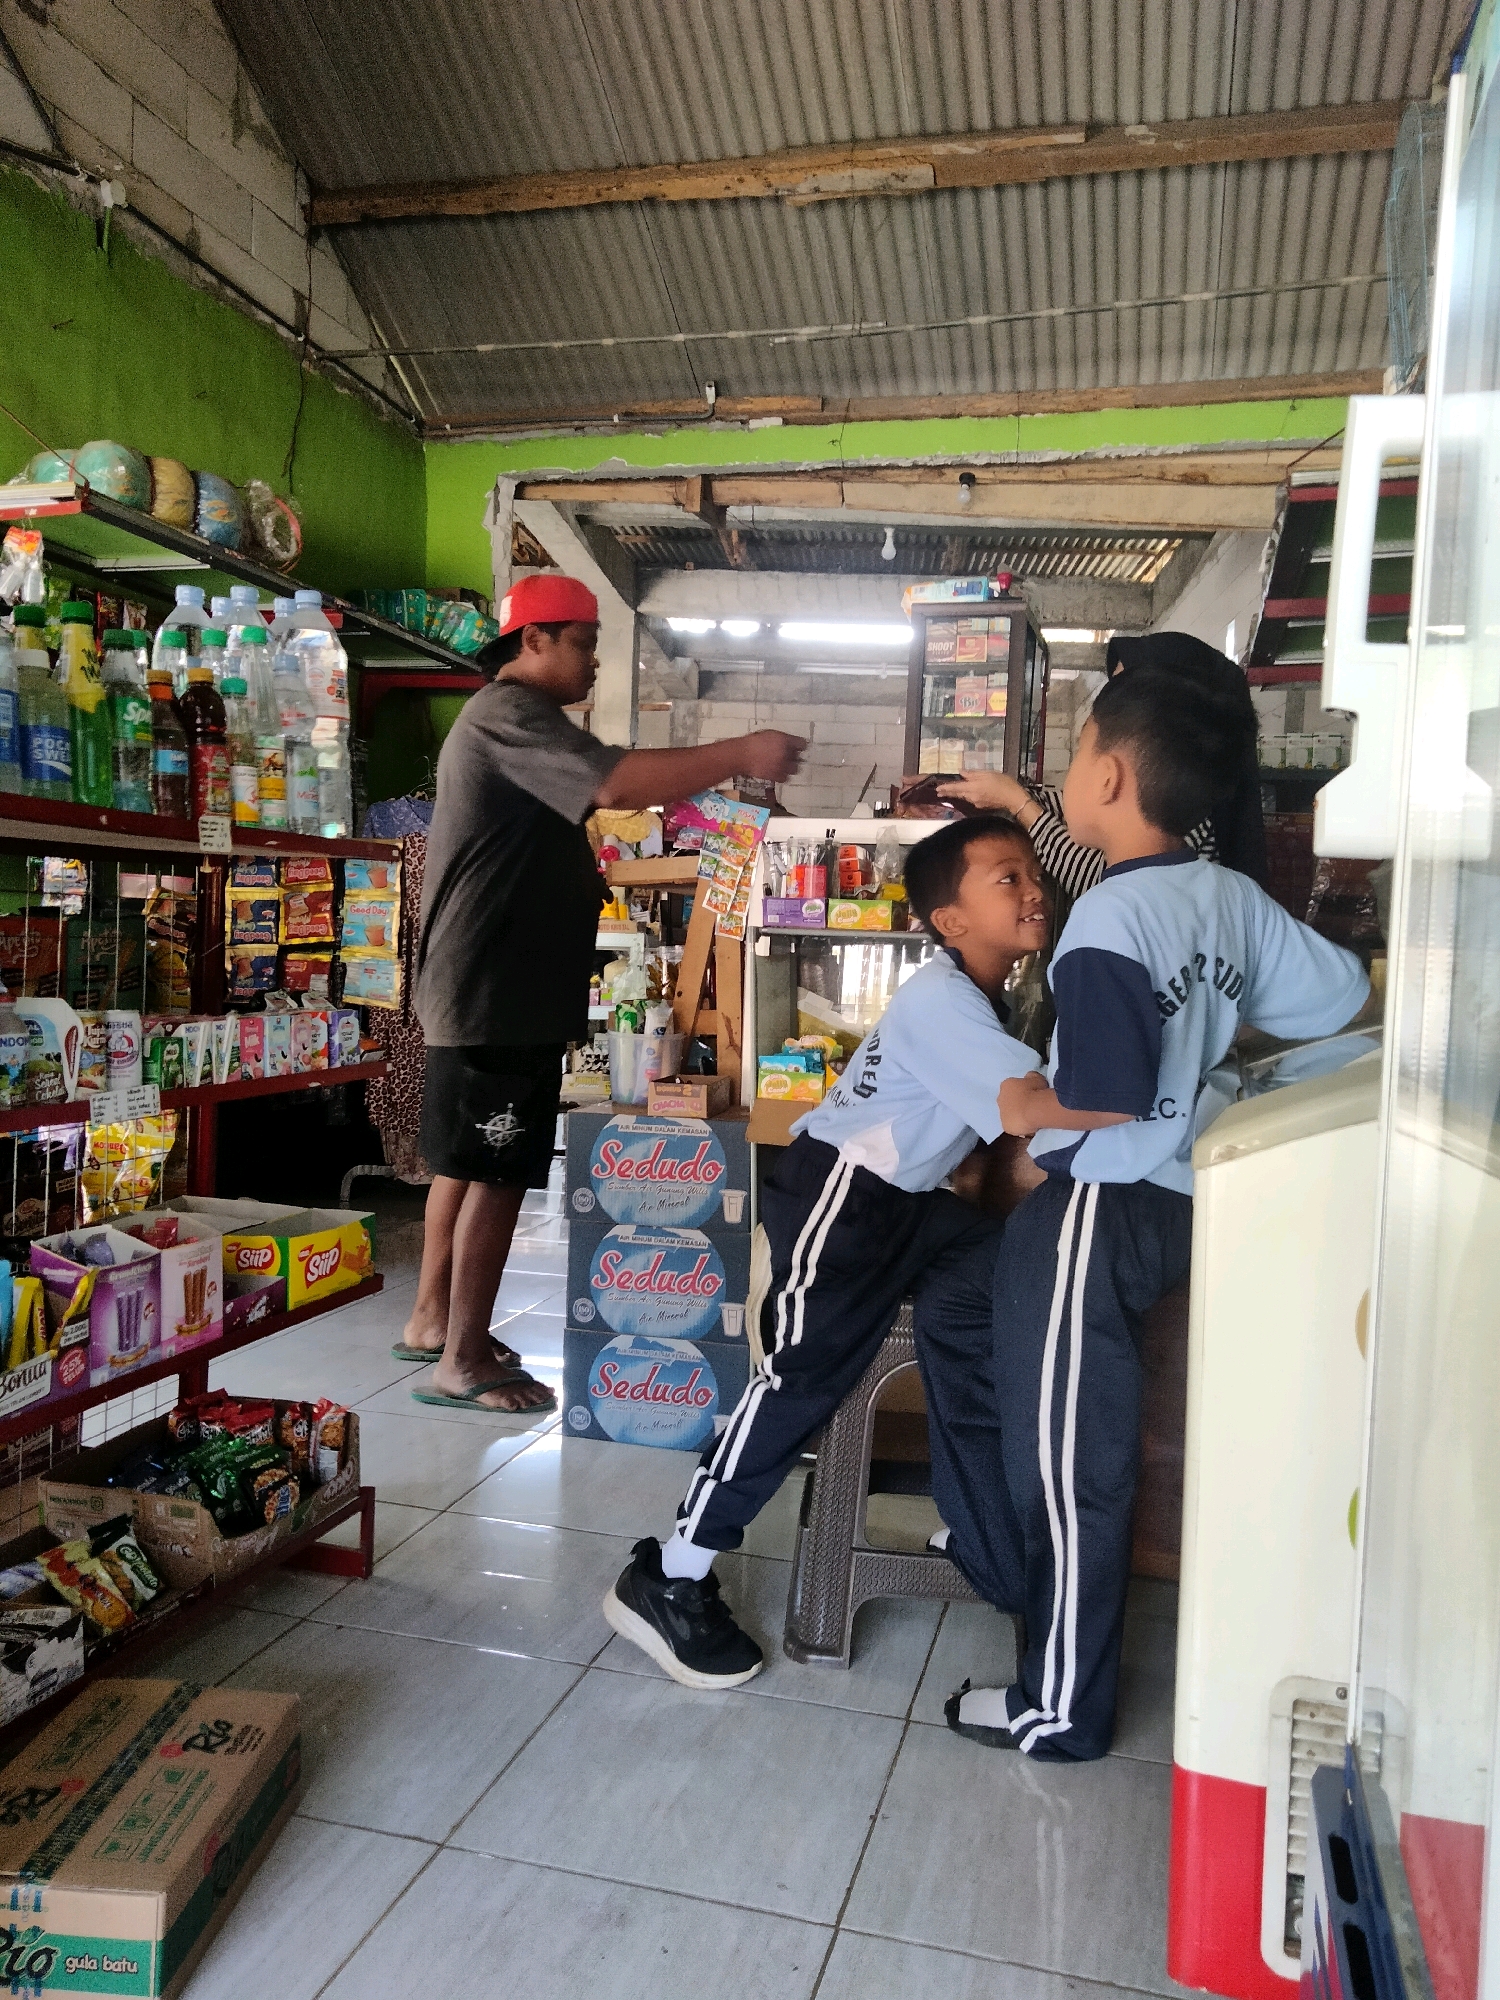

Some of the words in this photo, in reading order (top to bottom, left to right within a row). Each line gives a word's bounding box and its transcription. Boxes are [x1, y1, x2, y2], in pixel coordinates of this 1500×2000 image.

[927, 641, 955, 651] SHOOT
[350, 905, 371, 915] Good
[372, 906, 389, 916] Day
[652, 1100, 685, 1112] CHACHA
[677, 1127, 708, 1135] KEMASAN
[592, 1139, 725, 1184] Sedudo
[656, 1197, 690, 1211] Mineral
[653, 1237, 676, 1245] DALAM
[676, 1238, 708, 1247] KEMASAN
[237, 1248, 272, 1268] Siip
[306, 1247, 340, 1282] Siip
[591, 1249, 724, 1297] Sedudo
[656, 1309, 690, 1323] Mineral
[590, 1361, 716, 1408] Sedudo
[65, 1953, 98, 1974] gula
[102, 1955, 138, 1974] batu
